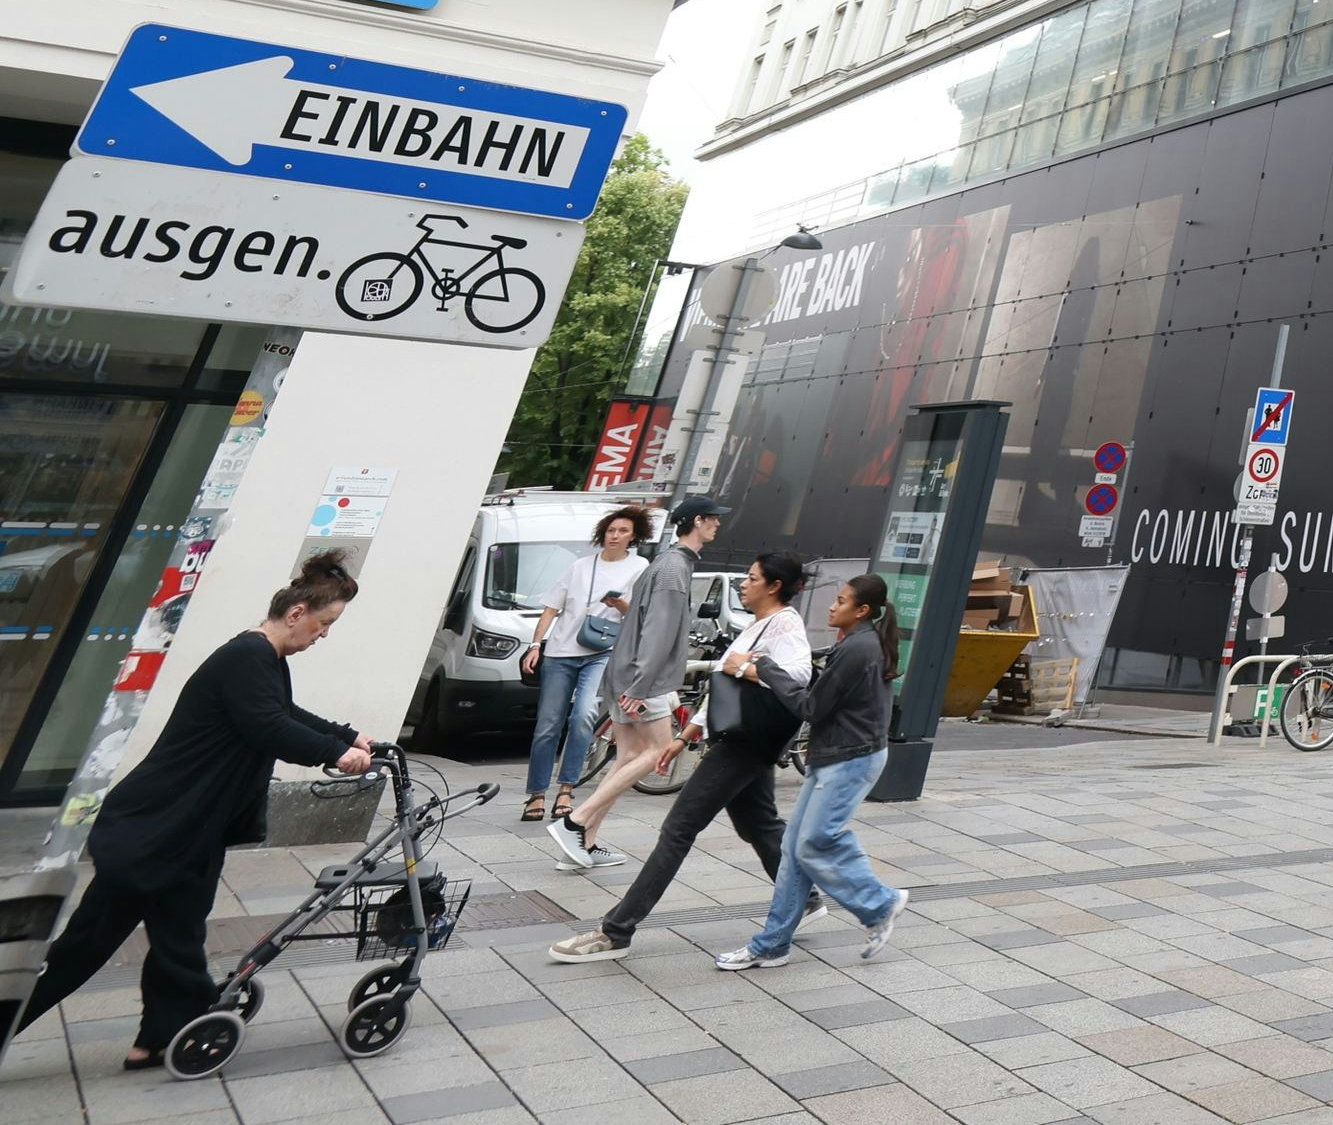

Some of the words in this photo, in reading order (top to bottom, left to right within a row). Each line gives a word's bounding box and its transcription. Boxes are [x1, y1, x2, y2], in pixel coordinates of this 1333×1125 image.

[280, 90, 566, 178] EINBAHN
[48, 209, 332, 281] ausgen.
[805, 241, 876, 316] BACK
[589, 423, 638, 492] EMA
[1256, 457, 1272, 474] 30
